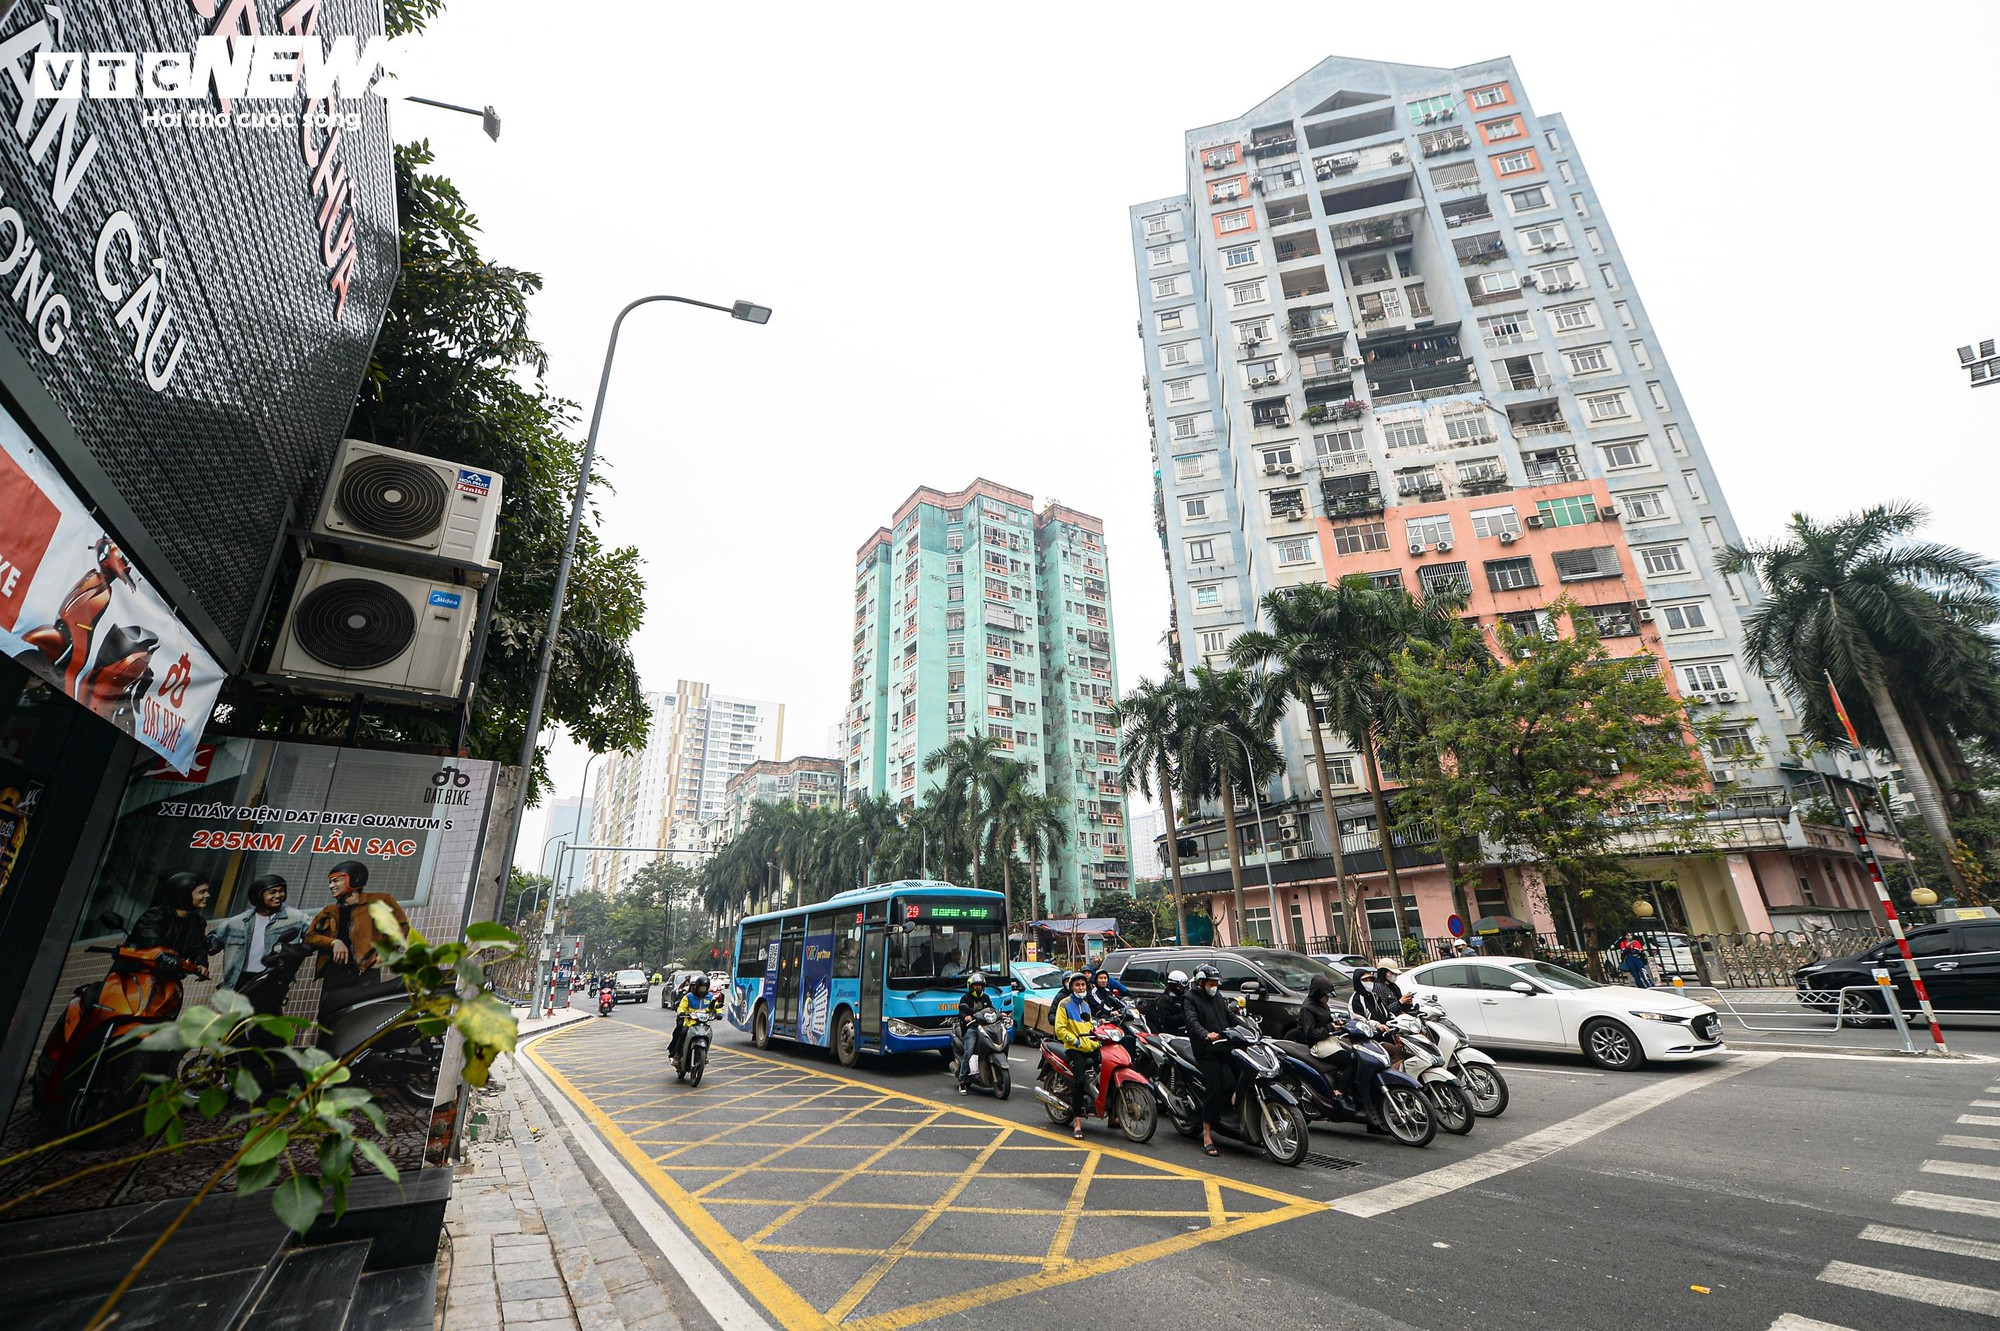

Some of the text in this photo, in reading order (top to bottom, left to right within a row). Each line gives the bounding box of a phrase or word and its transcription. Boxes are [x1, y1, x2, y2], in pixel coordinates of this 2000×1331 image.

[0, 190, 72, 356] ƠNG
[457, 483, 487, 496] Funiki
[435, 596, 458, 606] Midea
[423, 787, 472, 806] DAT.BIKE
[158, 801, 454, 831] XE MÁY ĐIỆN DAT BIKE QUANTUM S
[190, 829, 285, 852] 285KM
[311, 828, 362, 855] LẦN
[365, 837, 417, 860] SẠC
[906, 905, 920, 918] 29
